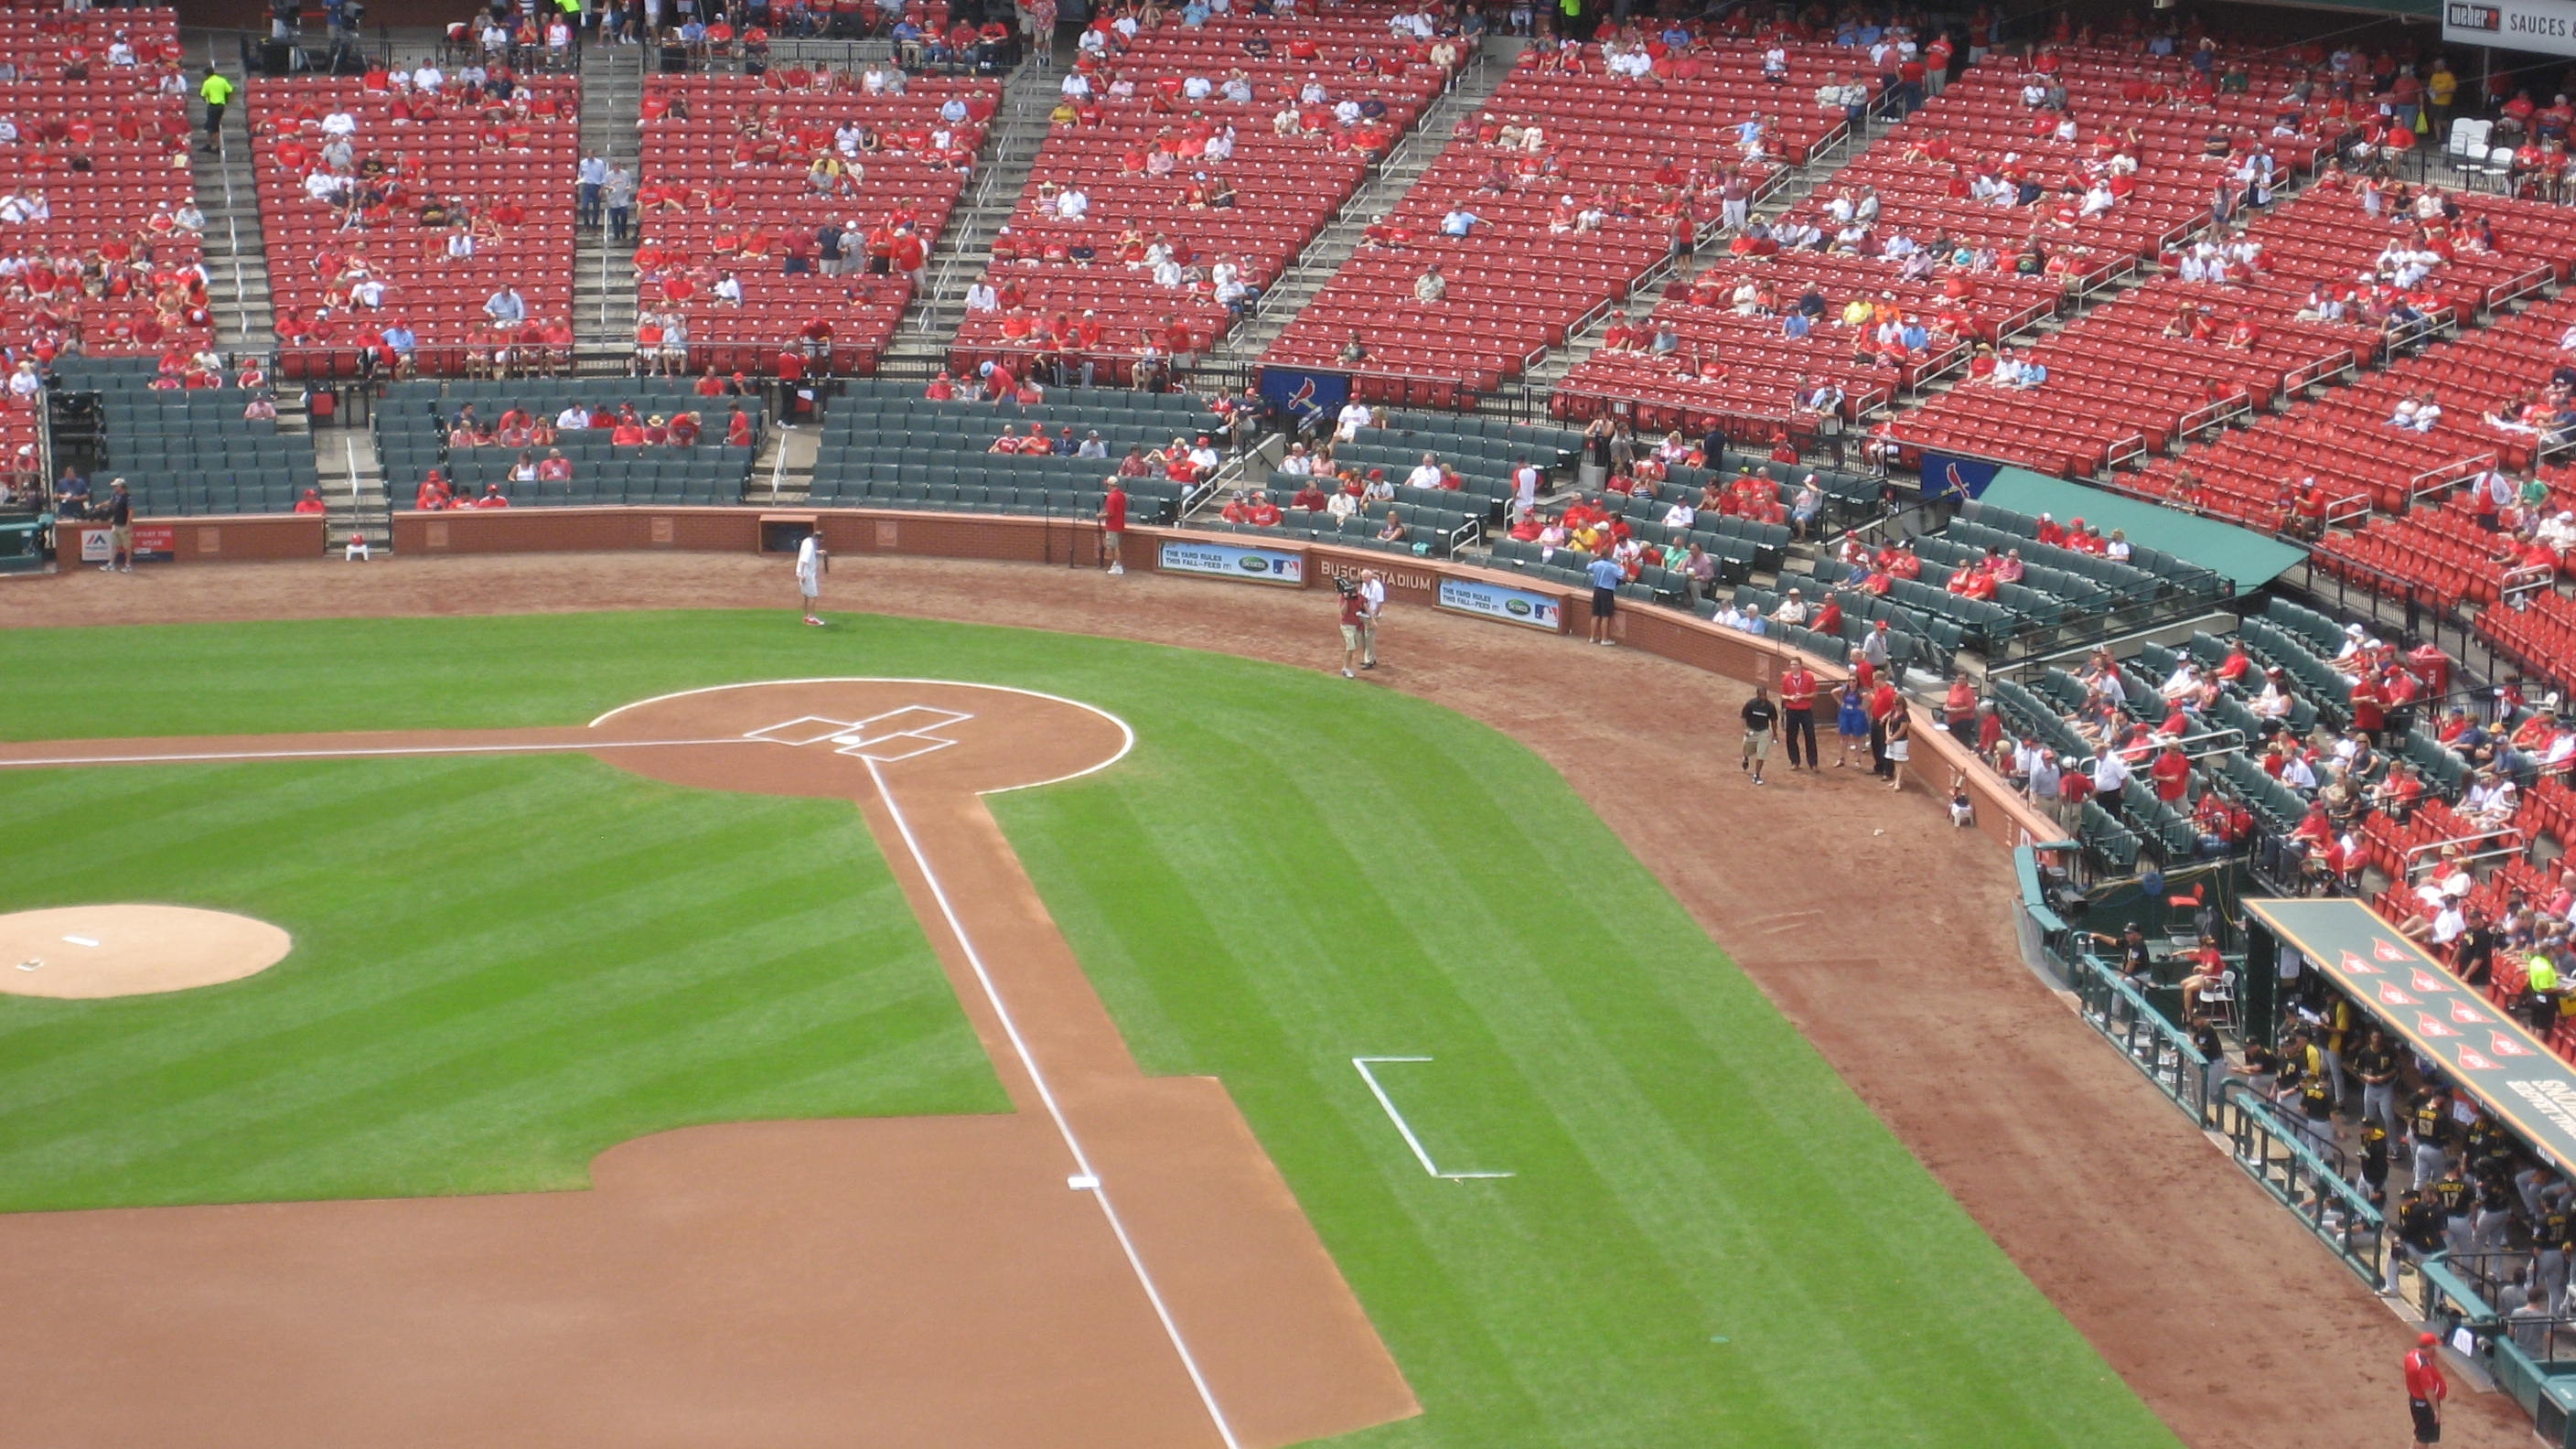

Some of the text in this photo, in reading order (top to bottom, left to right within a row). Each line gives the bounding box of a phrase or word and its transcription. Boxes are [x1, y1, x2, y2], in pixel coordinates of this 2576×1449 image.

[2452, 5, 2487, 27] weber
[2510, 15, 2565, 37] SAUCES
[1165, 549, 1223, 562] THE YARD RULES
[1165, 556, 1180, 564] THIS
[1443, 586, 1491, 603] THE YARD RULES
[1443, 594, 1455, 603] THIS
[2442, 1191, 2460, 1208] 17
